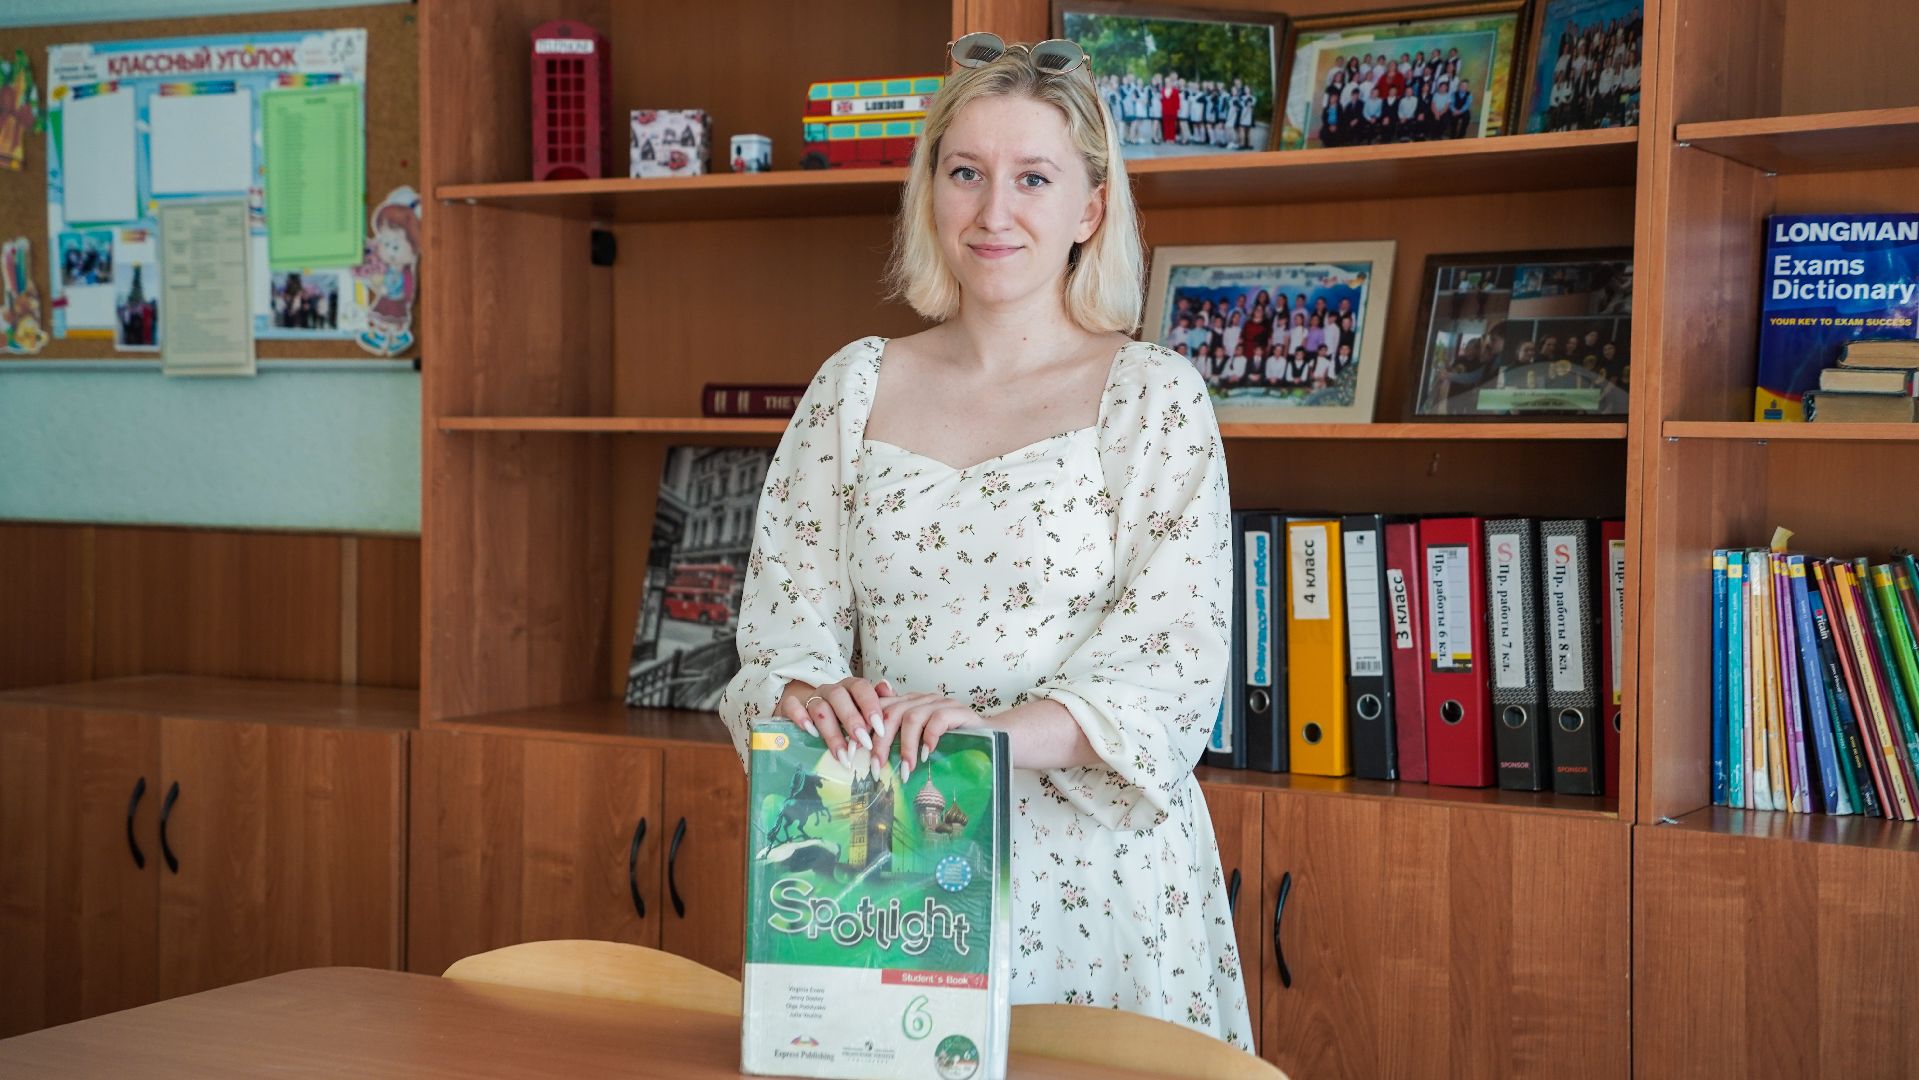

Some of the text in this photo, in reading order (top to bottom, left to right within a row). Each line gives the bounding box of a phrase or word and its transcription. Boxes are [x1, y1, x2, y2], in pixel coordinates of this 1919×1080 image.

[107, 47, 212, 75] КЛАССНЫЙ
[218, 48, 297, 71] УГОЛОК
[865, 100, 904, 111] LONDON
[1775, 222, 1919, 242] LONGMAN
[1774, 254, 1865, 276] Exams
[1772, 278, 1916, 305] Dictionary
[1769, 317, 1912, 327] YOUR KEY TO EXAM SUCCESS
[1304, 539, 1316, 604] 4 класс
[1432, 554, 1445, 576] Пр.
[1393, 576, 1409, 640] 3 класс
[1433, 580, 1447, 627] работы
[1497, 564, 1512, 673] Пр. работы 7 кл.
[1552, 565, 1569, 675] Пр. работы 8 кл.
[1439, 641, 1447, 661] кл.
[1500, 761, 1530, 769] SPONSOR
[768, 877, 970, 956] Spotlight
[946, 975, 969, 985] Book
[901, 994, 933, 1041] 6
